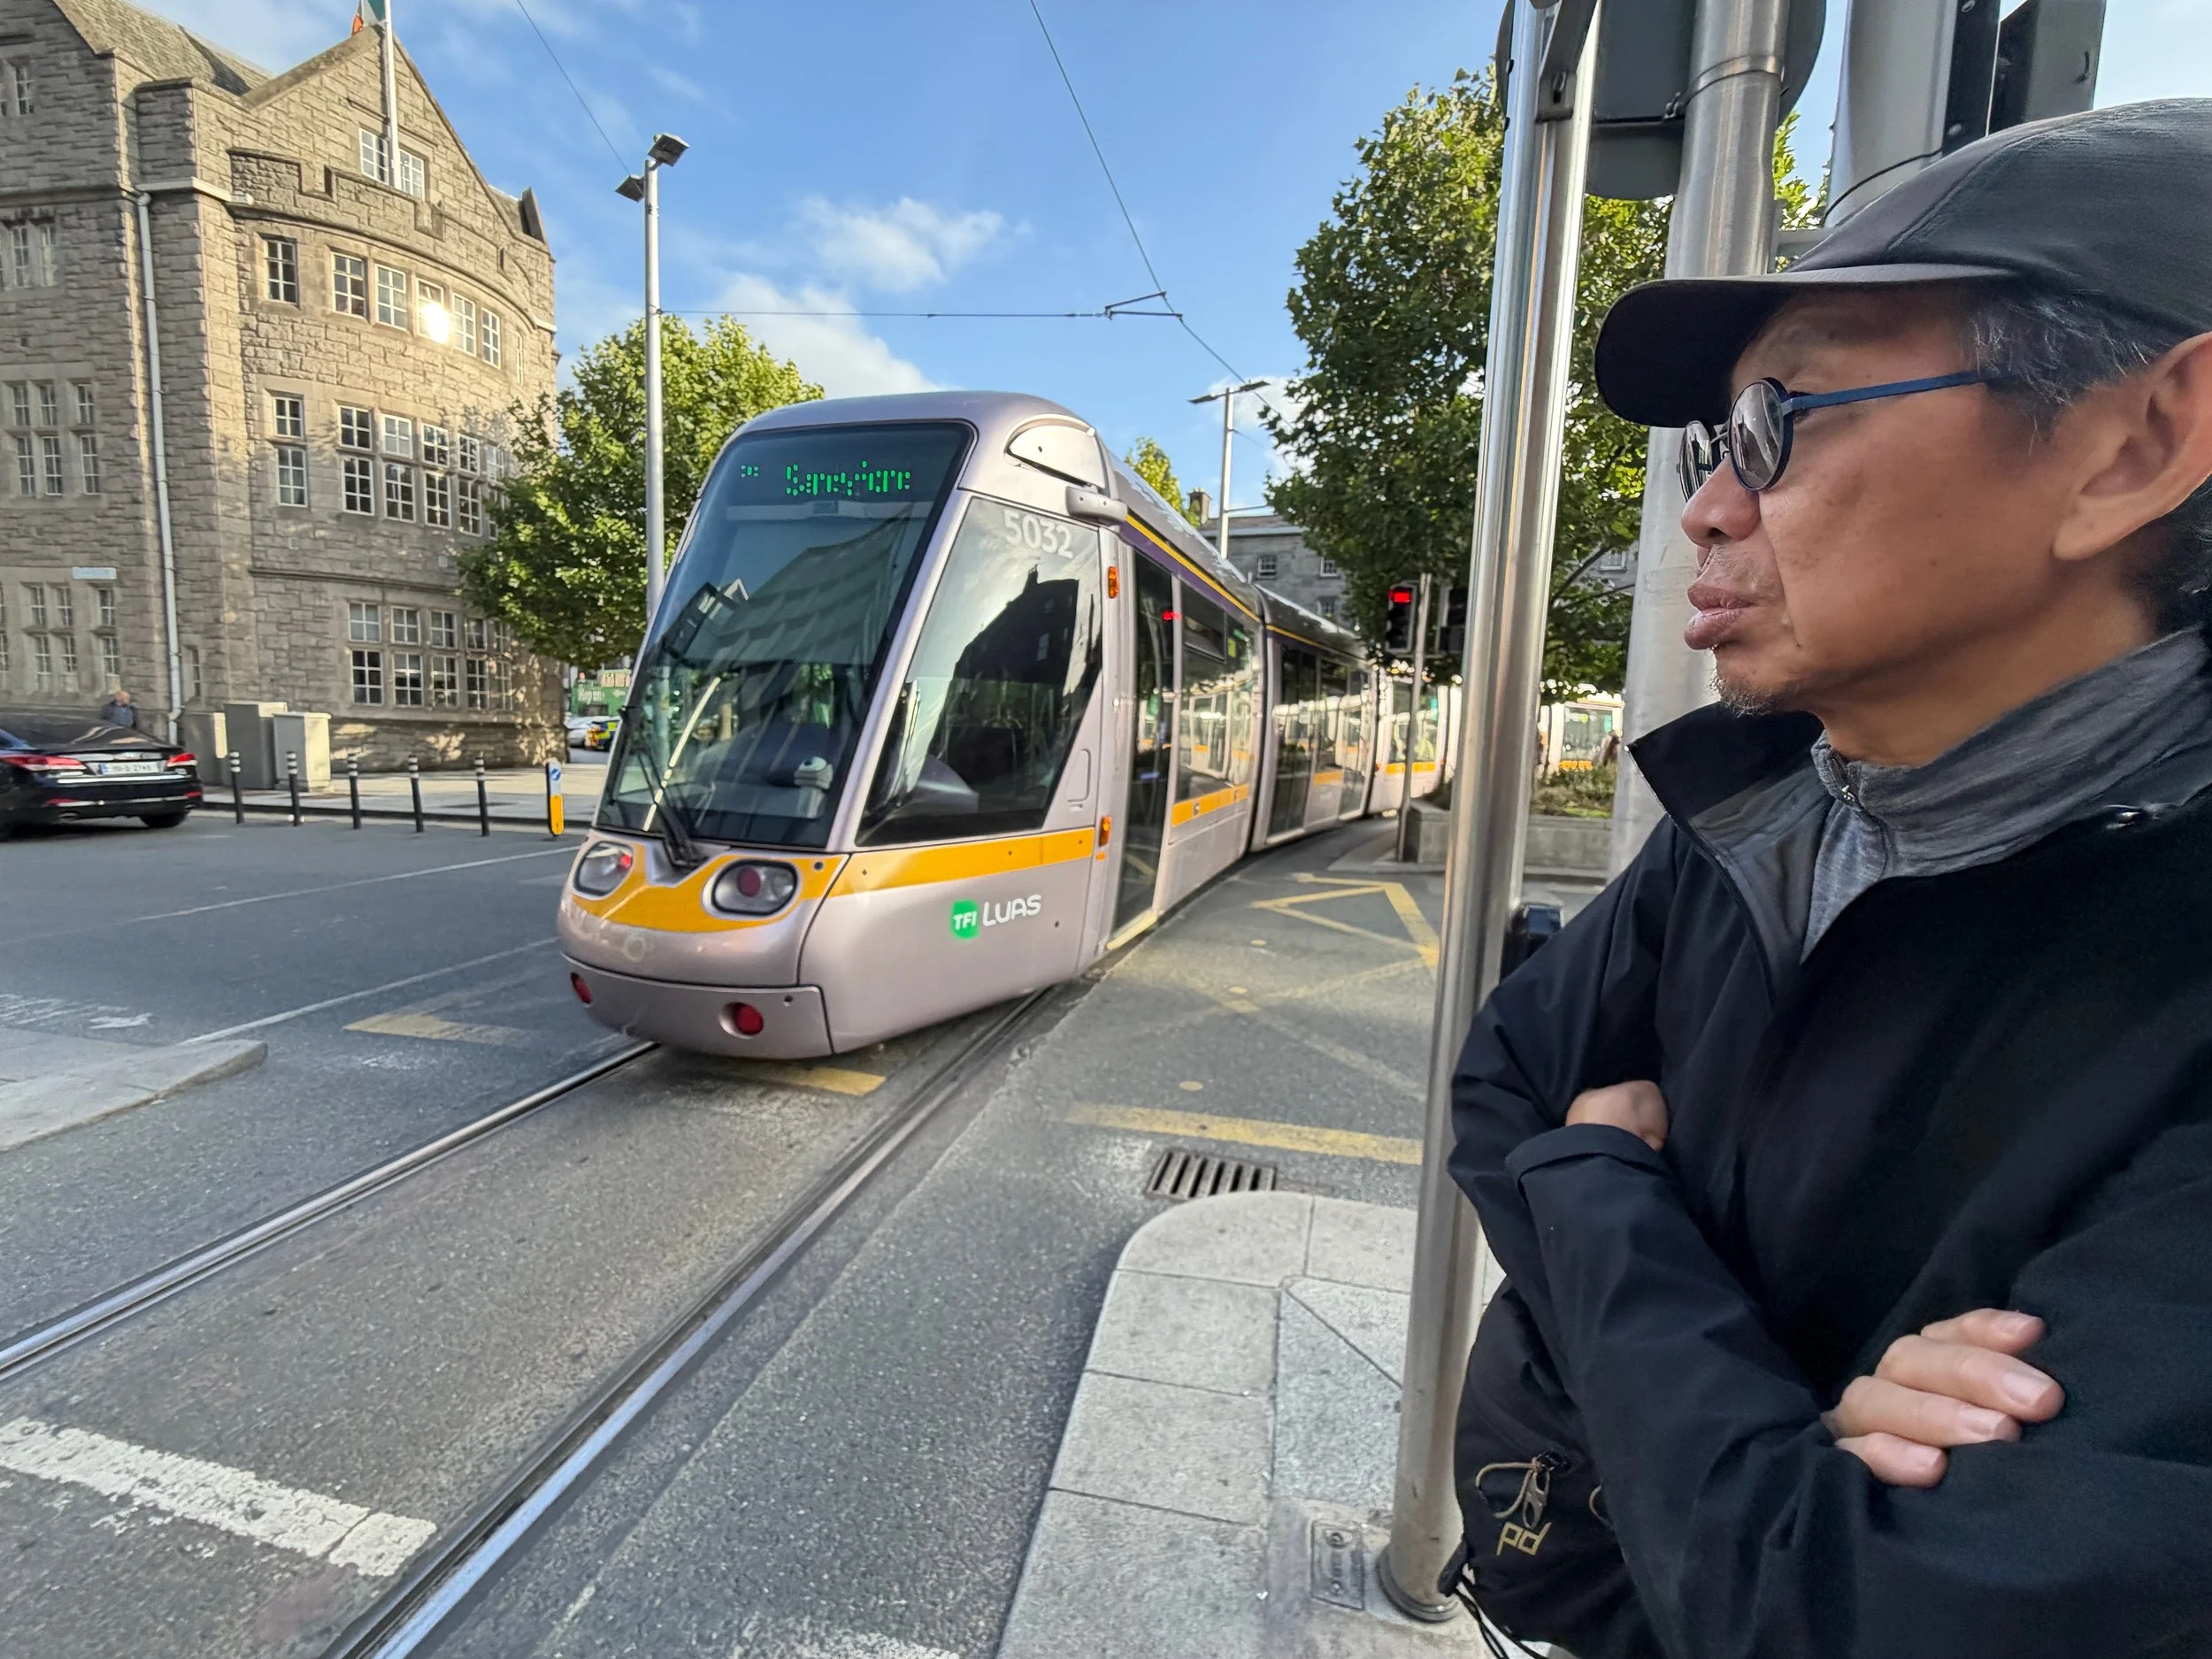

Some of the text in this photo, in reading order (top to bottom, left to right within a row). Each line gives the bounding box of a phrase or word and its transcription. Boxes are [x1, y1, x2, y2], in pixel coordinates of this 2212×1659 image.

[1003, 509, 1074, 559] 5032
[953, 894, 1042, 931] TFI LUAS
